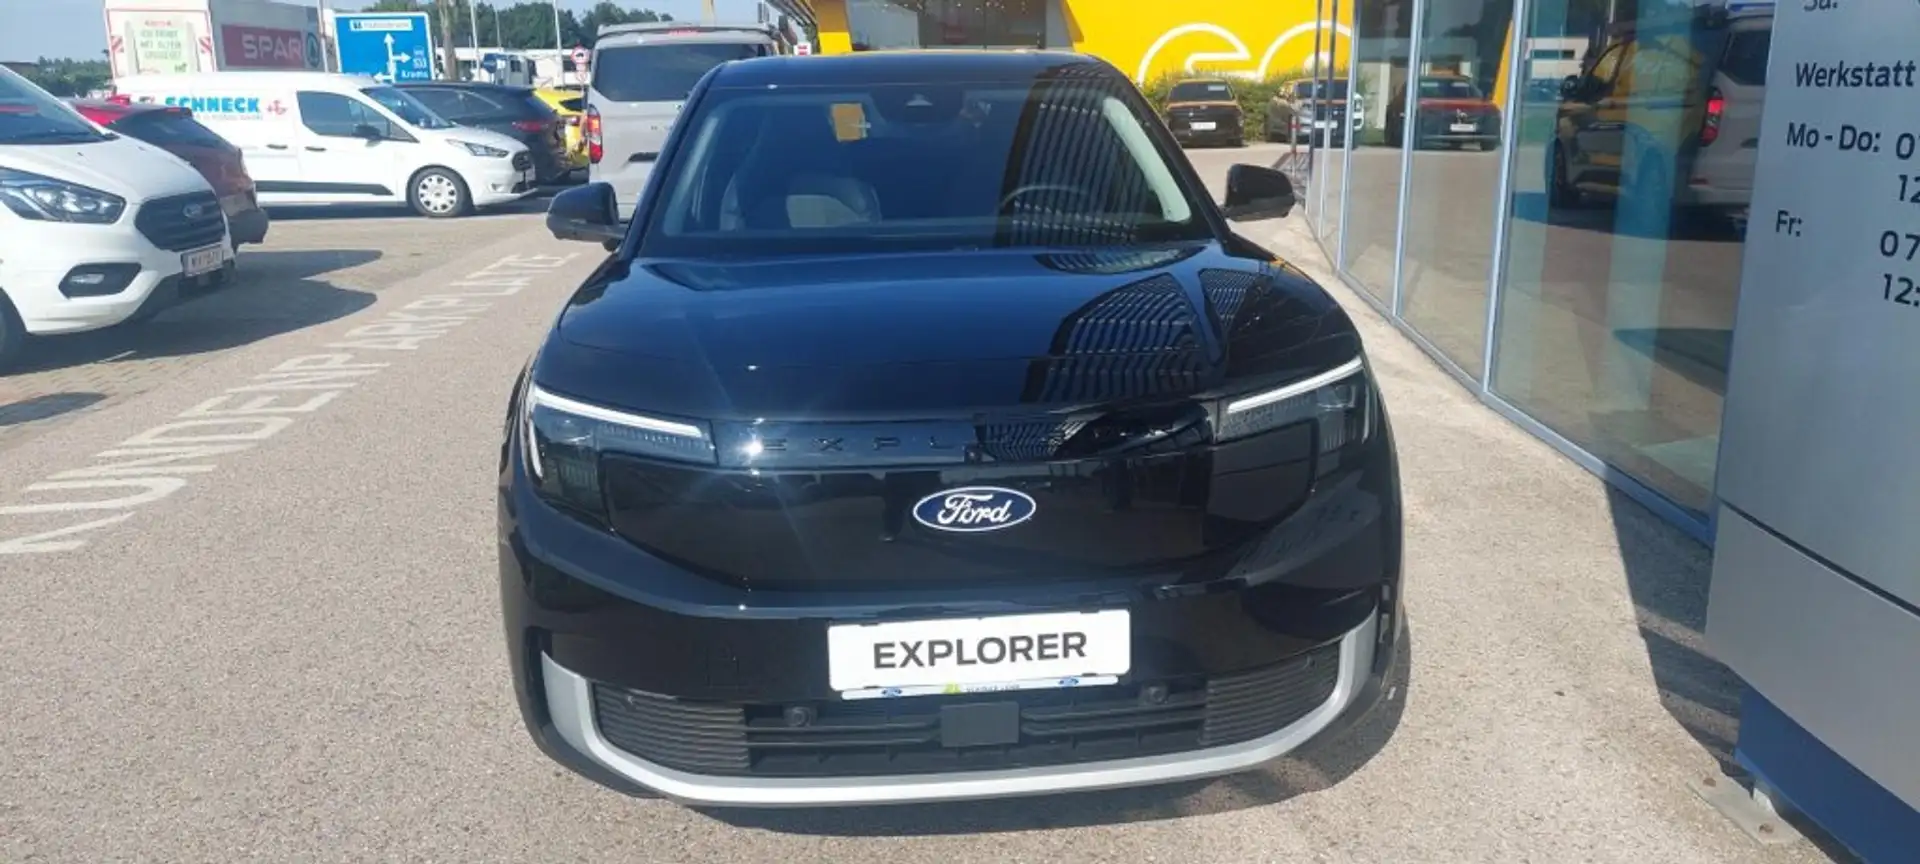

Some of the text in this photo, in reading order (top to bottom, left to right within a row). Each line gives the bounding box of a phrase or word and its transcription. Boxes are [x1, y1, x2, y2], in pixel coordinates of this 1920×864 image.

[242, 34, 302, 60] SPAR
[401, 70, 429, 79] Krems
[1796, 60, 1916, 88] Werkstatt
[165, 96, 260, 114] SCHNECK
[1895, 132, 1920, 161] 0
[1775, 210, 1802, 237] Fr:
[937, 494, 1011, 525] Ford
[873, 631, 1088, 670] EXPLORER
